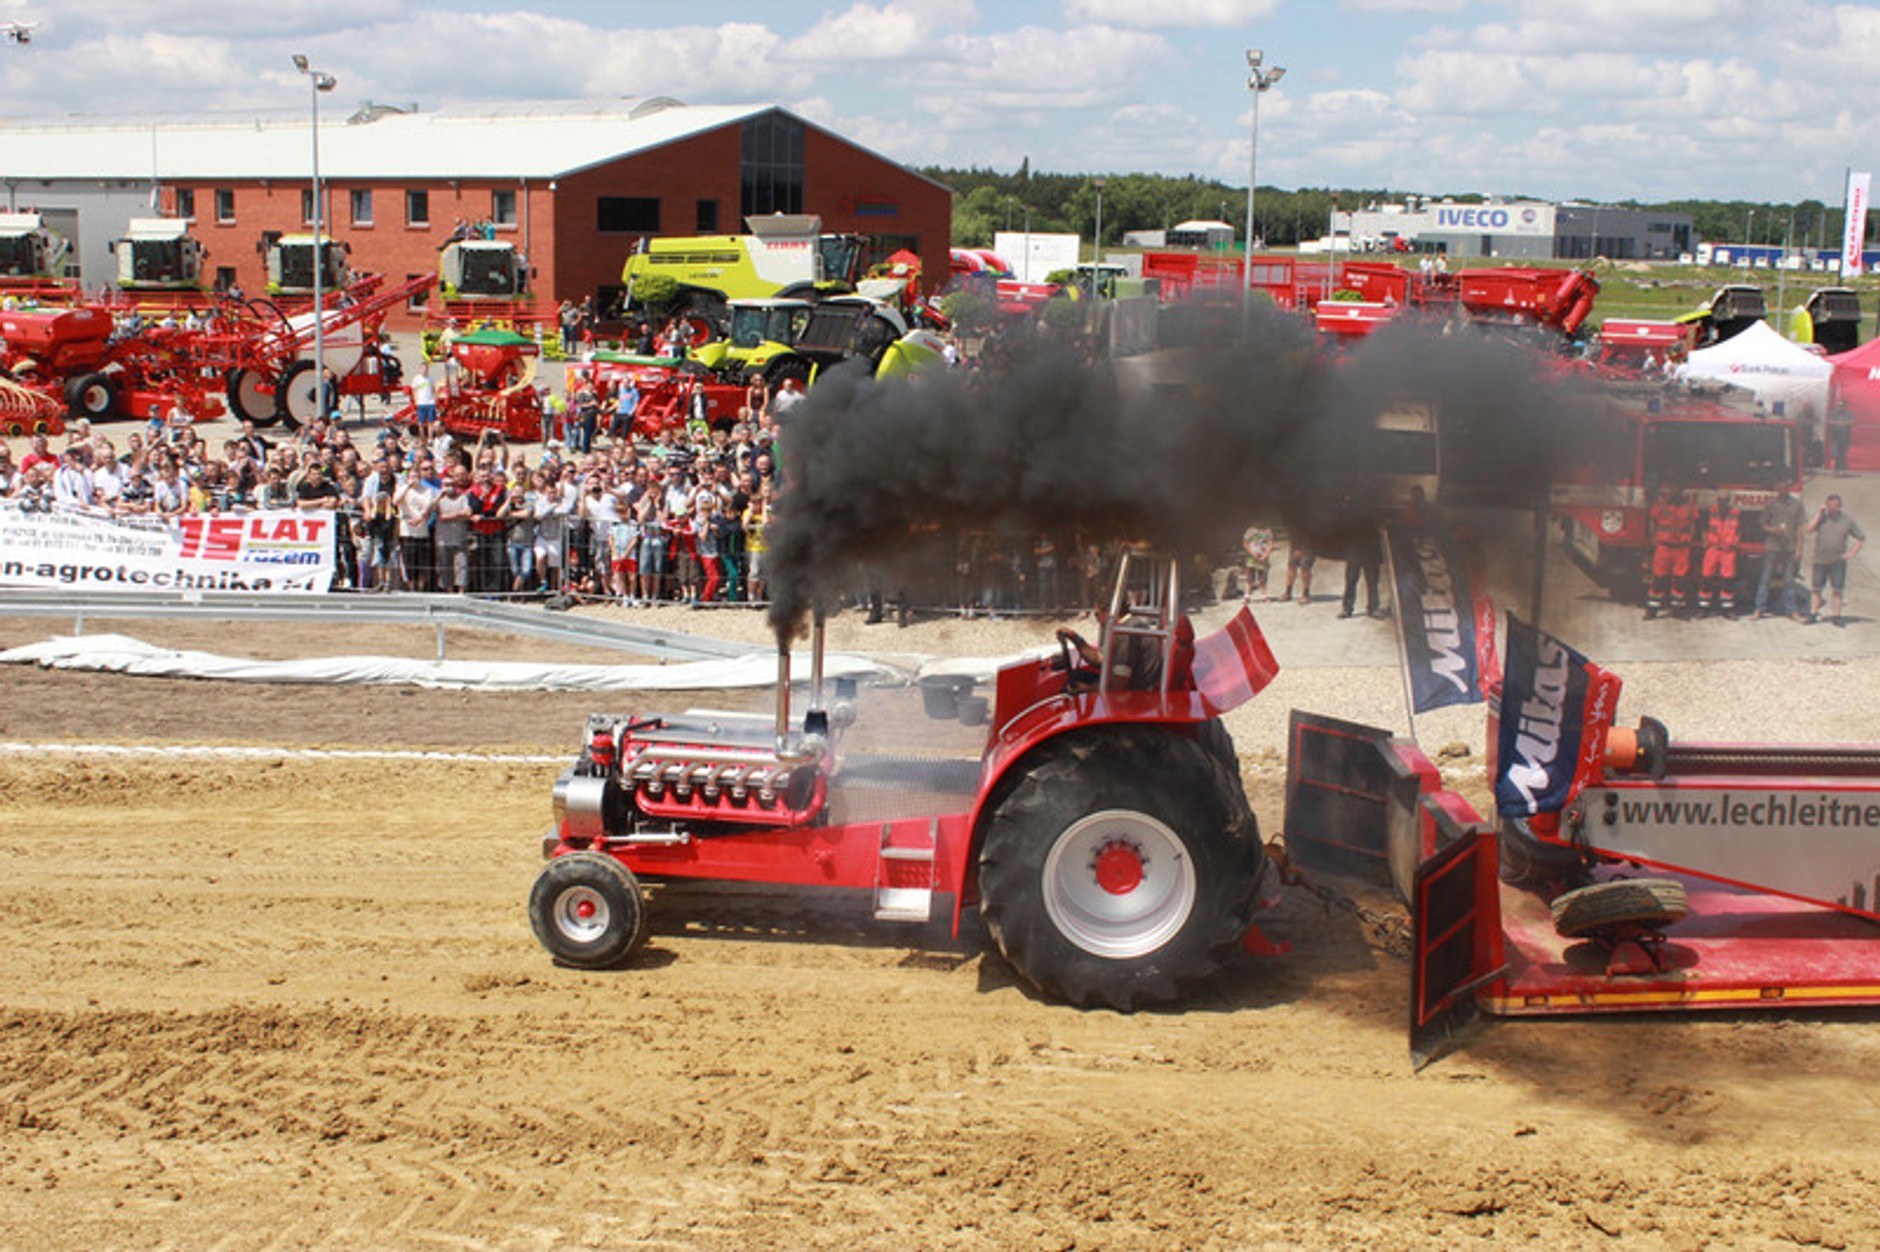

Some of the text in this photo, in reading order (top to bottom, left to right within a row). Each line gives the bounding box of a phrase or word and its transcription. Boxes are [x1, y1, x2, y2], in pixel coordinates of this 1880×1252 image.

[1438, 208, 1508, 228] IVECO
[178, 518, 245, 561] 15
[249, 518, 327, 542] LAT
[1507, 632, 1569, 814] Mitas
[1623, 793, 1880, 828] www.lechleitne
